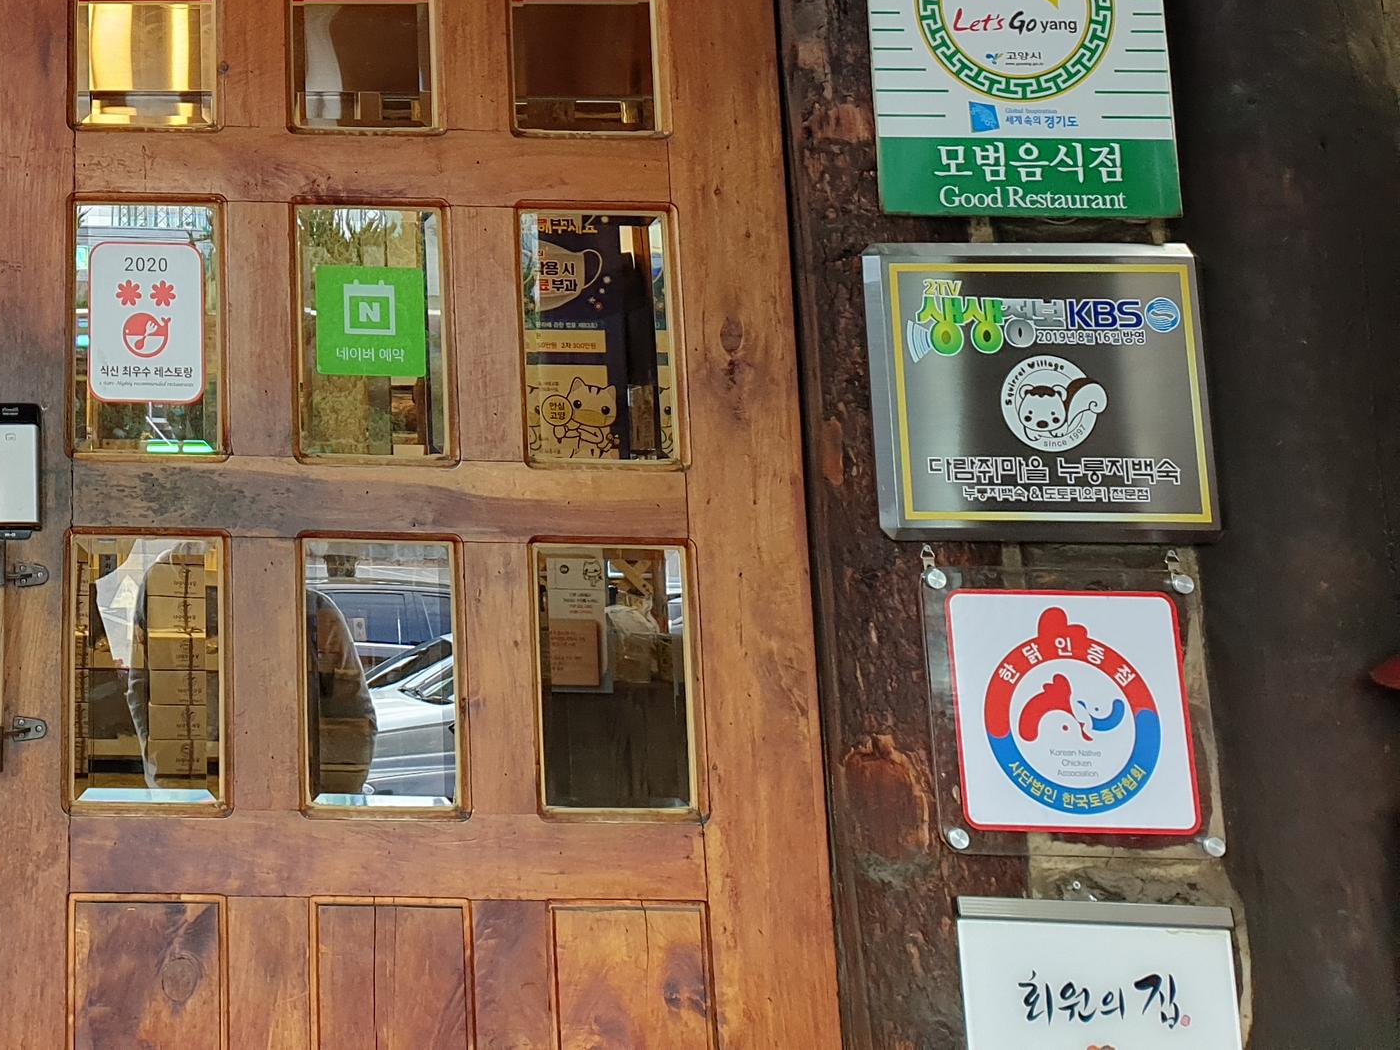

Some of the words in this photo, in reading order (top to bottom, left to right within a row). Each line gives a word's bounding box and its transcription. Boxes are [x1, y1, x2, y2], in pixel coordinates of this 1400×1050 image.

[953, 7, 1005, 33] Let's
[1006, 51, 1042, 61] 고양시
[1044, 115, 1079, 129] 경기도
[933, 141, 1124, 184] 모범음식점
[939, 185, 1003, 210] Good
[1006, 185, 1128, 210] Restaurant
[123, 257, 169, 273] 2020
[923, 279, 962, 296] 2TV
[1066, 298, 1144, 329] KBS
[1036, 331, 1077, 345] 2019년
[1076, 331, 1095, 345] 8월
[1096, 331, 1122, 345] 16일
[1122, 330, 1146, 345] 방영
[335, 345, 375, 363] 네이버
[379, 346, 405, 363] 예약
[100, 365, 119, 378] 식신
[122, 365, 152, 378] 최우수
[153, 366, 193, 379] 레스토랑
[1004, 368, 1027, 406] Squirrel
[1043, 439, 1068, 448] since
[1068, 424, 1087, 443] 1997
[926, 456, 1050, 483] 다람쥐마을
[1057, 457, 1182, 484] 누룽지백숙
[962, 486, 1029, 502] 누룽지백숙
[1030, 487, 1043, 501] &
[1043, 487, 1109, 502] 도토리요리
[1109, 487, 1151, 503] 전문점
[1007, 760, 1058, 804] 사단법인
[1062, 767, 1147, 810] 한국토종닭협회
[1017, 969, 1127, 1026] 회원의
[1133, 973, 1181, 1030] 집
